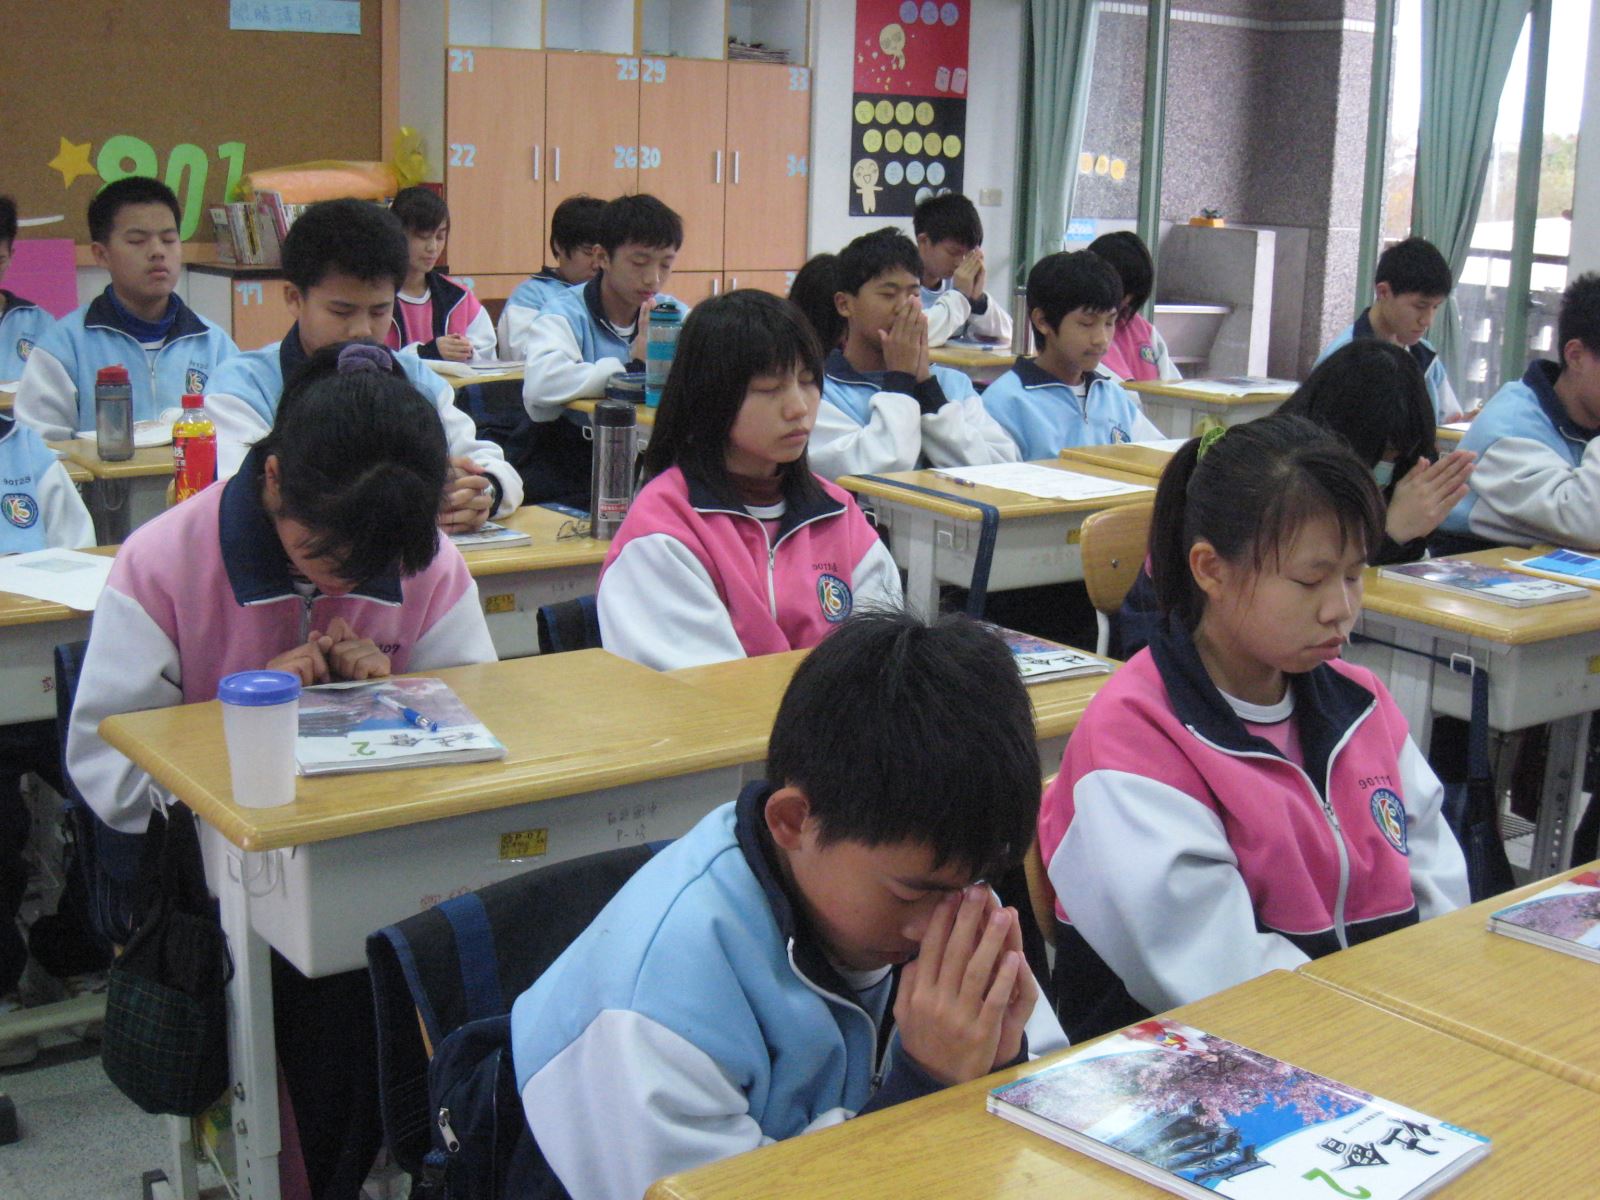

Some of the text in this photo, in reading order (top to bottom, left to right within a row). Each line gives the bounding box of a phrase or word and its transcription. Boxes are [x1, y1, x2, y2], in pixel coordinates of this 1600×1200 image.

[449, 50, 474, 72] 21
[616, 59, 638, 81] 25
[643, 60, 666, 83] 29
[450, 144, 476, 167] 22
[614, 145, 637, 168] 26
[641, 145, 661, 169] 30
[97, 135, 246, 241] 901
[1358, 775, 1393, 790] 90111
[1301, 1167, 1372, 1200] 2
